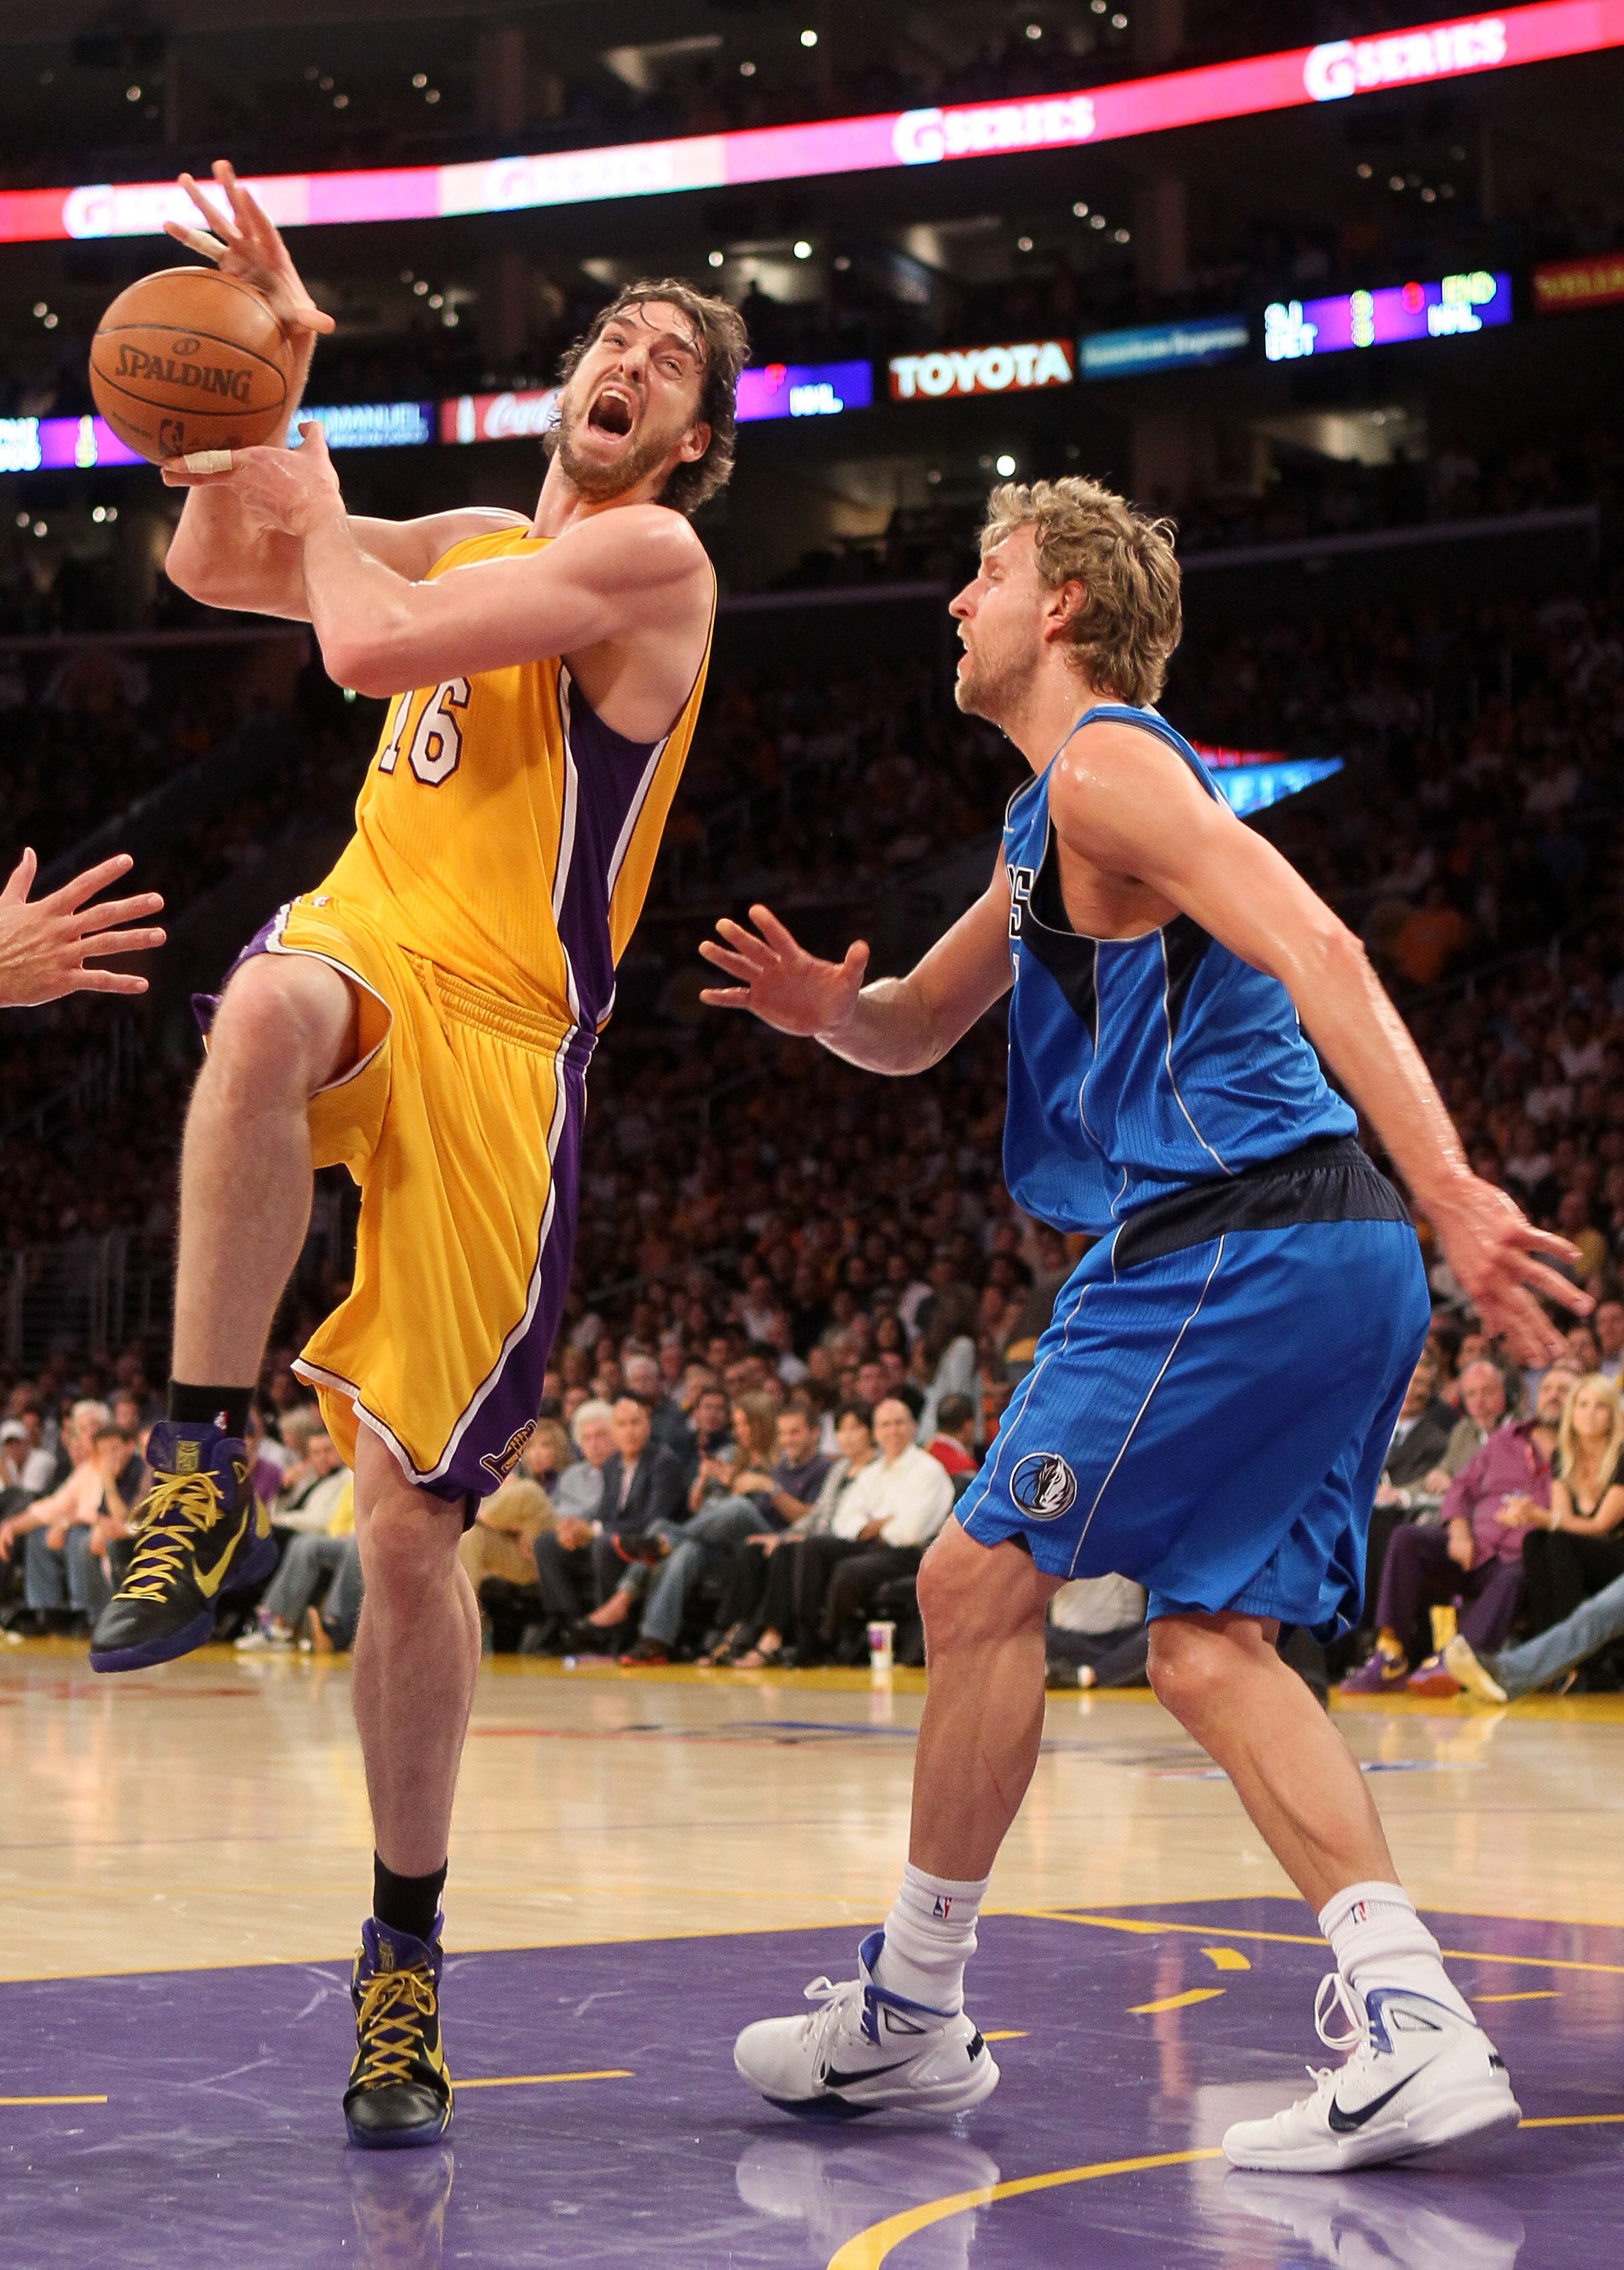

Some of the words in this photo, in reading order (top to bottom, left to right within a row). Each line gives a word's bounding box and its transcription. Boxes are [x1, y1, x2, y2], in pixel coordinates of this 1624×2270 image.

[116, 343, 253, 404] SPALDING
[889, 341, 1073, 399] TOYOTA
[378, 677, 472, 788] 16
